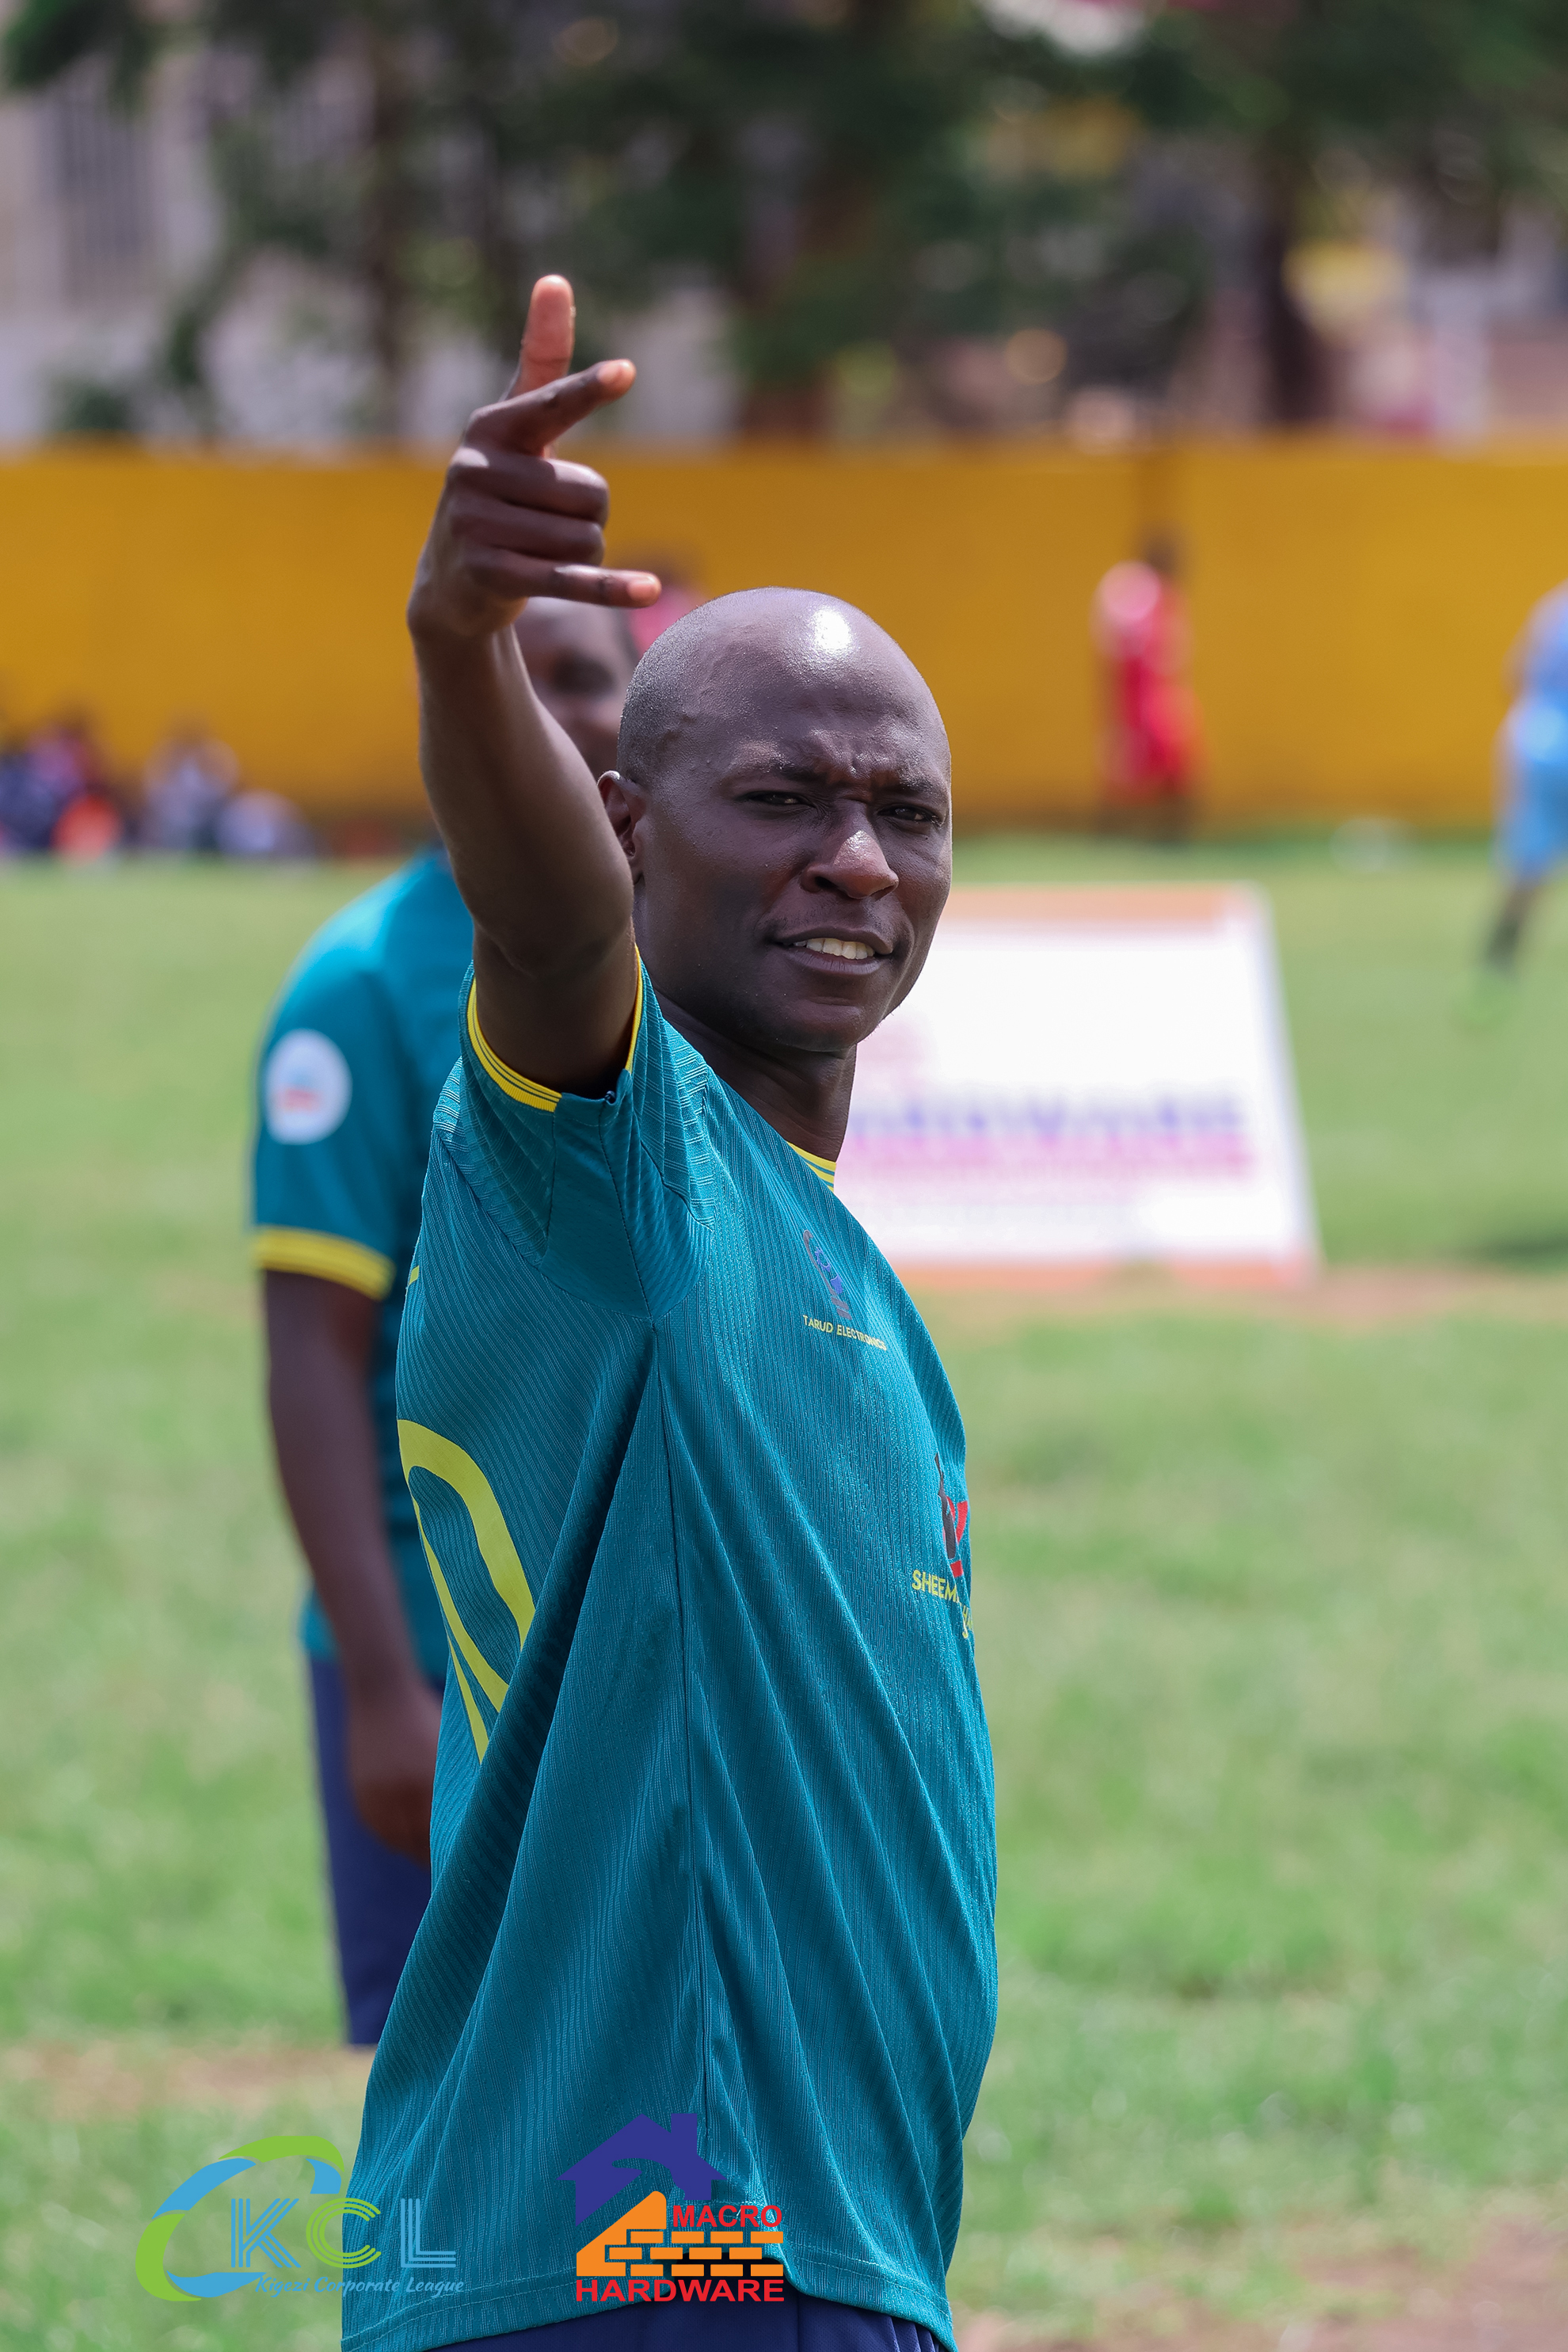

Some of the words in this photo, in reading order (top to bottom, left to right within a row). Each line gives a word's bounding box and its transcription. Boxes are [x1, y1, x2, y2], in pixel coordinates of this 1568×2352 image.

[803, 1315, 833, 1334] TARUD
[836, 1324, 887, 1351] ELECTRONICS
[911, 1569, 961, 1606] SHEEM
